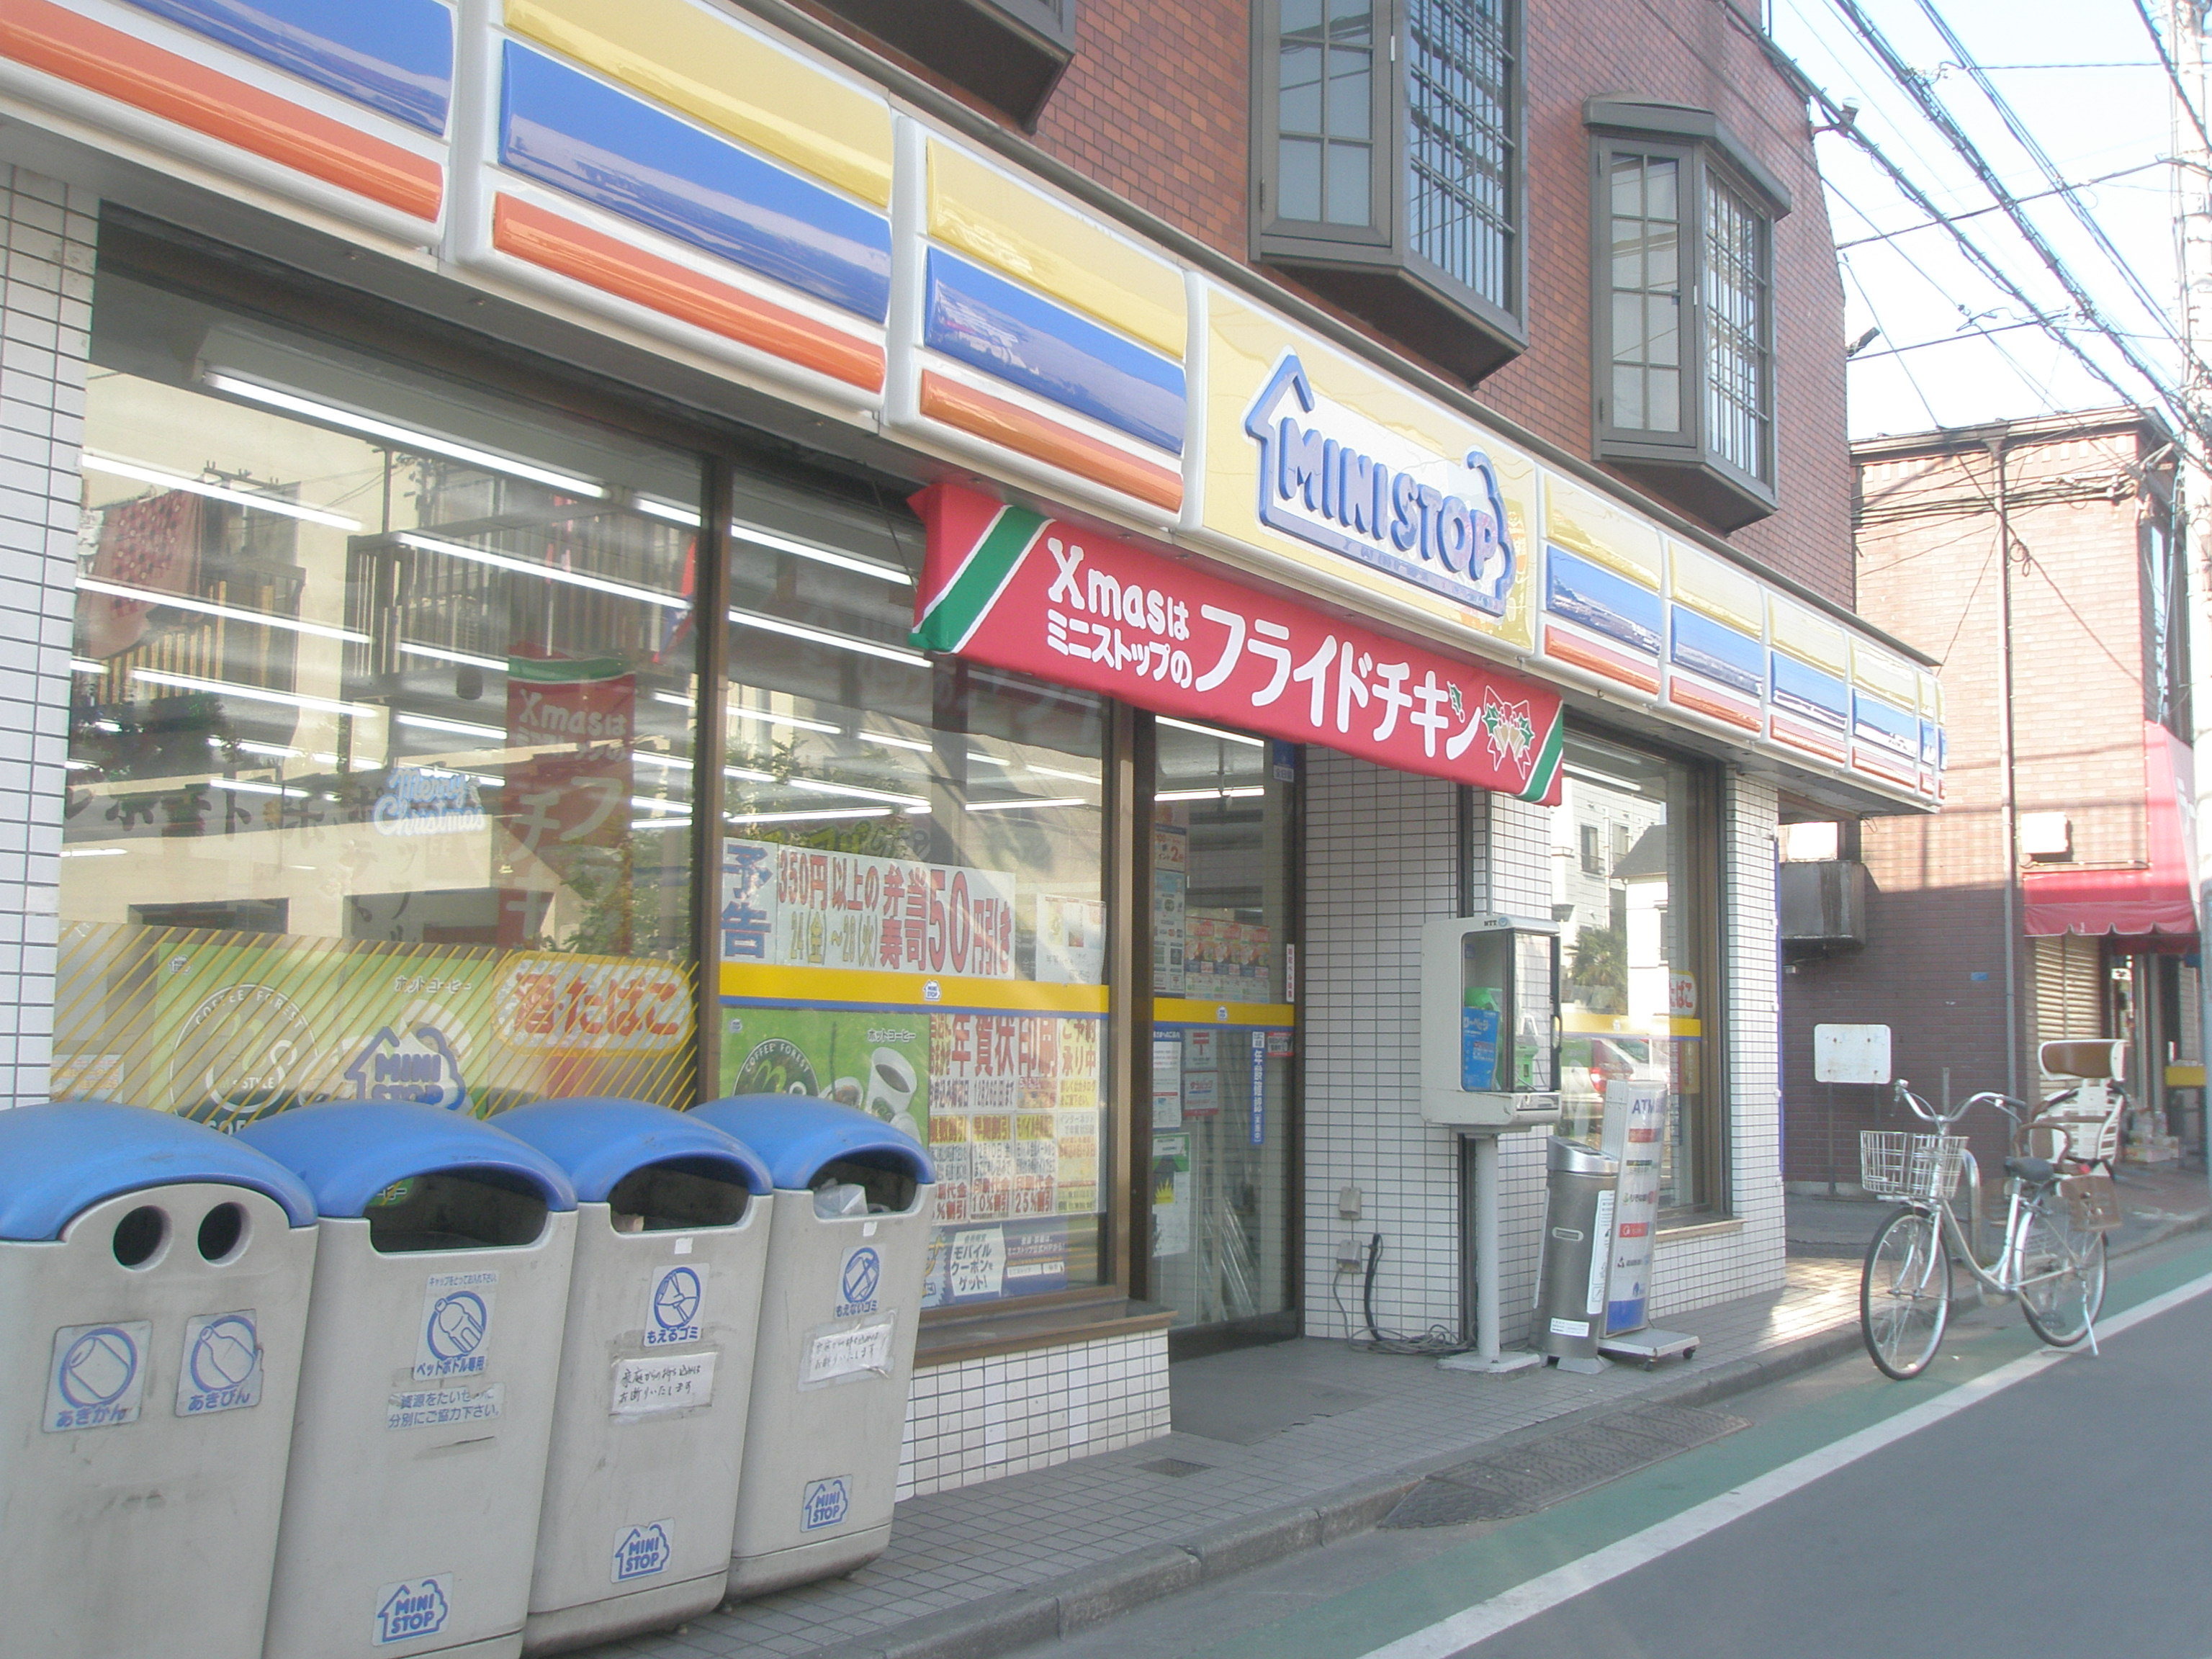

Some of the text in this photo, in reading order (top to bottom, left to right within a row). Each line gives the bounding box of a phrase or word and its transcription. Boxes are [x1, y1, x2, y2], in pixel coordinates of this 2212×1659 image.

[1046, 536, 1190, 641] Xmasは
[1047, 608, 1193, 690] ミニストップの
[1195, 603, 1481, 760] フライドチキン
[390, 767, 469, 807] Merry
[373, 791, 487, 837] Christmas
[721, 845, 773, 958] 予告
[867, 1028, 917, 1043] ホットコーヒー
[375, 1053, 441, 1082] MINI
[745, 1043, 809, 1073] COFFEE FOREST
[1632, 1098, 1657, 1115] ATM
[935, 1182, 967, 1200] 刷代金
[932, 1199, 966, 1220] %割引
[972, 1192, 1010, 1213] 10%割引
[1015, 1190, 1053, 1213] 25%割引
[953, 1243, 992, 1260] モバイル
[951, 1257, 994, 1277] クーポンを
[836, 1300, 878, 1318] もえないゴミ
[646, 1326, 699, 1344] もえるゴミ
[416, 1355, 486, 1377] ペットボトル専用
[188, 1388, 251, 1411] あきびん
[400, 1389, 495, 1410] 資源をたいせに
[56, 1406, 128, 1429] あきかん
[815, 1489, 840, 1508] MINI
[812, 1504, 839, 1522] STOP
[628, 1537, 660, 1555] MINI
[626, 1551, 660, 1572] STOP
[395, 1593, 435, 1616] MINI
[390, 1611, 436, 1635] STOP
